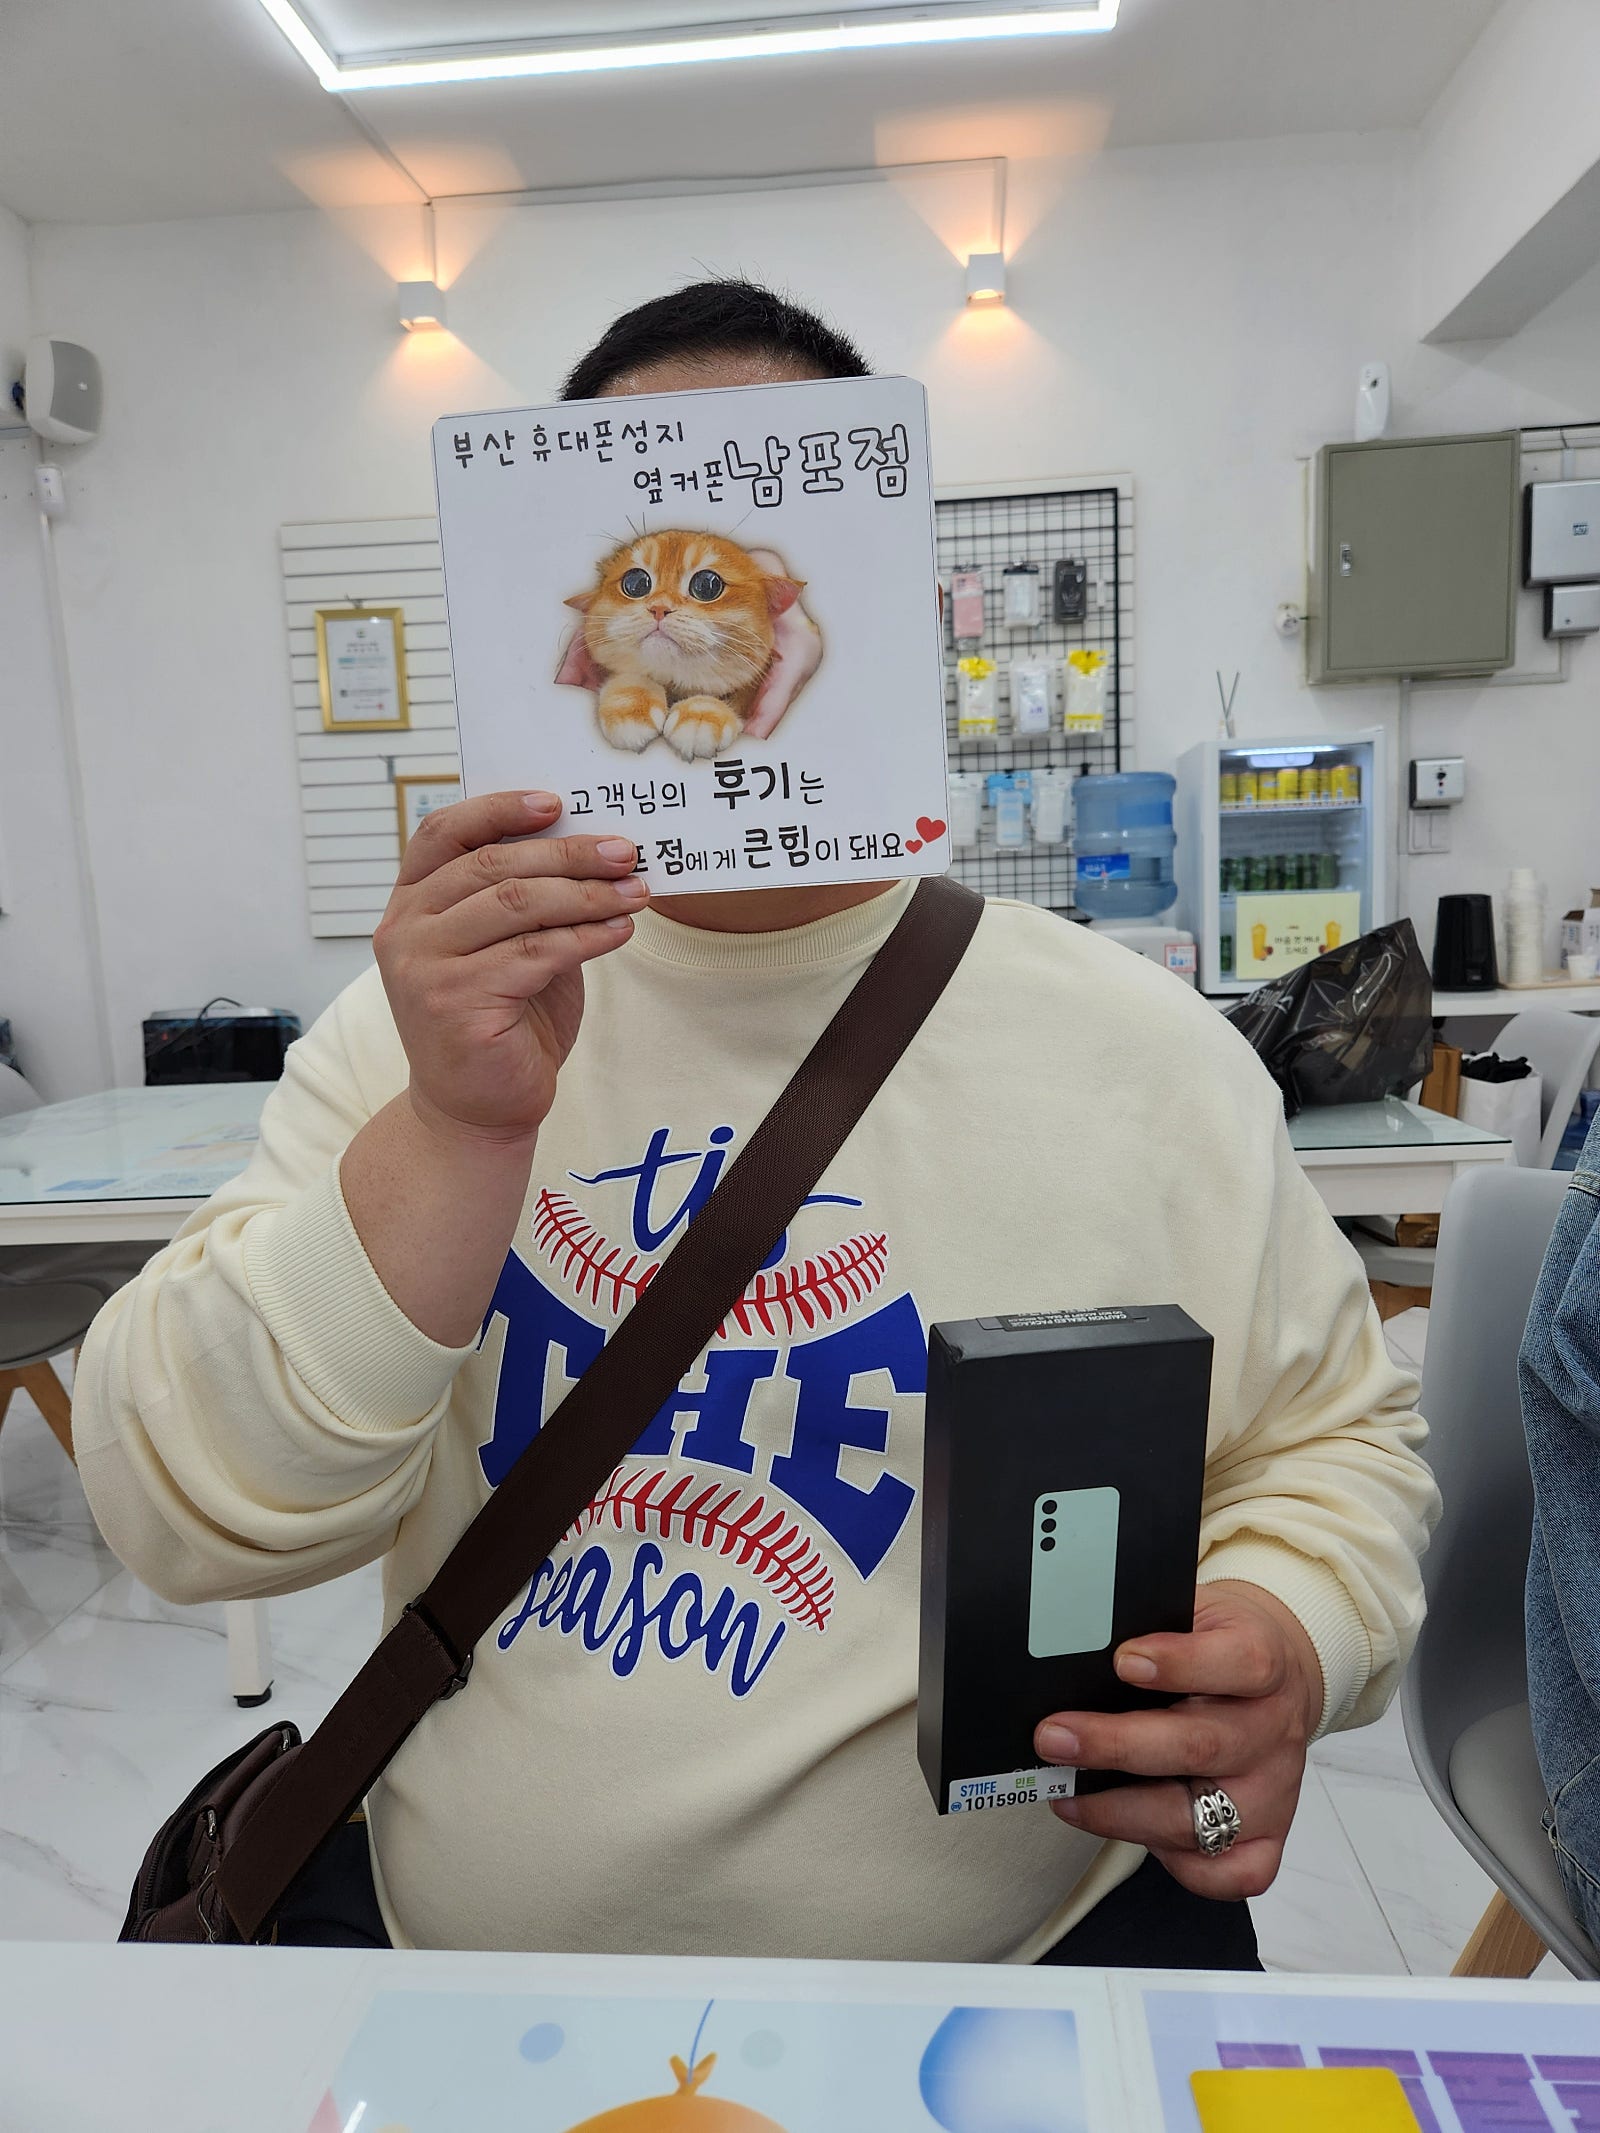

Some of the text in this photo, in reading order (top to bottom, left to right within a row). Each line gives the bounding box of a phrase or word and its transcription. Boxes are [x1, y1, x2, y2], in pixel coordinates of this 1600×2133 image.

[453, 420, 684, 469] 부산 휴대폰성지
[723, 423, 909, 508] 남포점
[569, 758, 825, 817] 고객님의 후기는
[848, 832, 905, 861] 돼요
[568, 1126, 862, 1268] ti
[1011, 1319, 1052, 1327] PACKAGE
[478, 1246, 928, 1580] THE
[499, 1542, 787, 1697] season
[960, 1776, 1036, 1797] S711FE 민트
[965, 1789, 1038, 1811] 1015905
